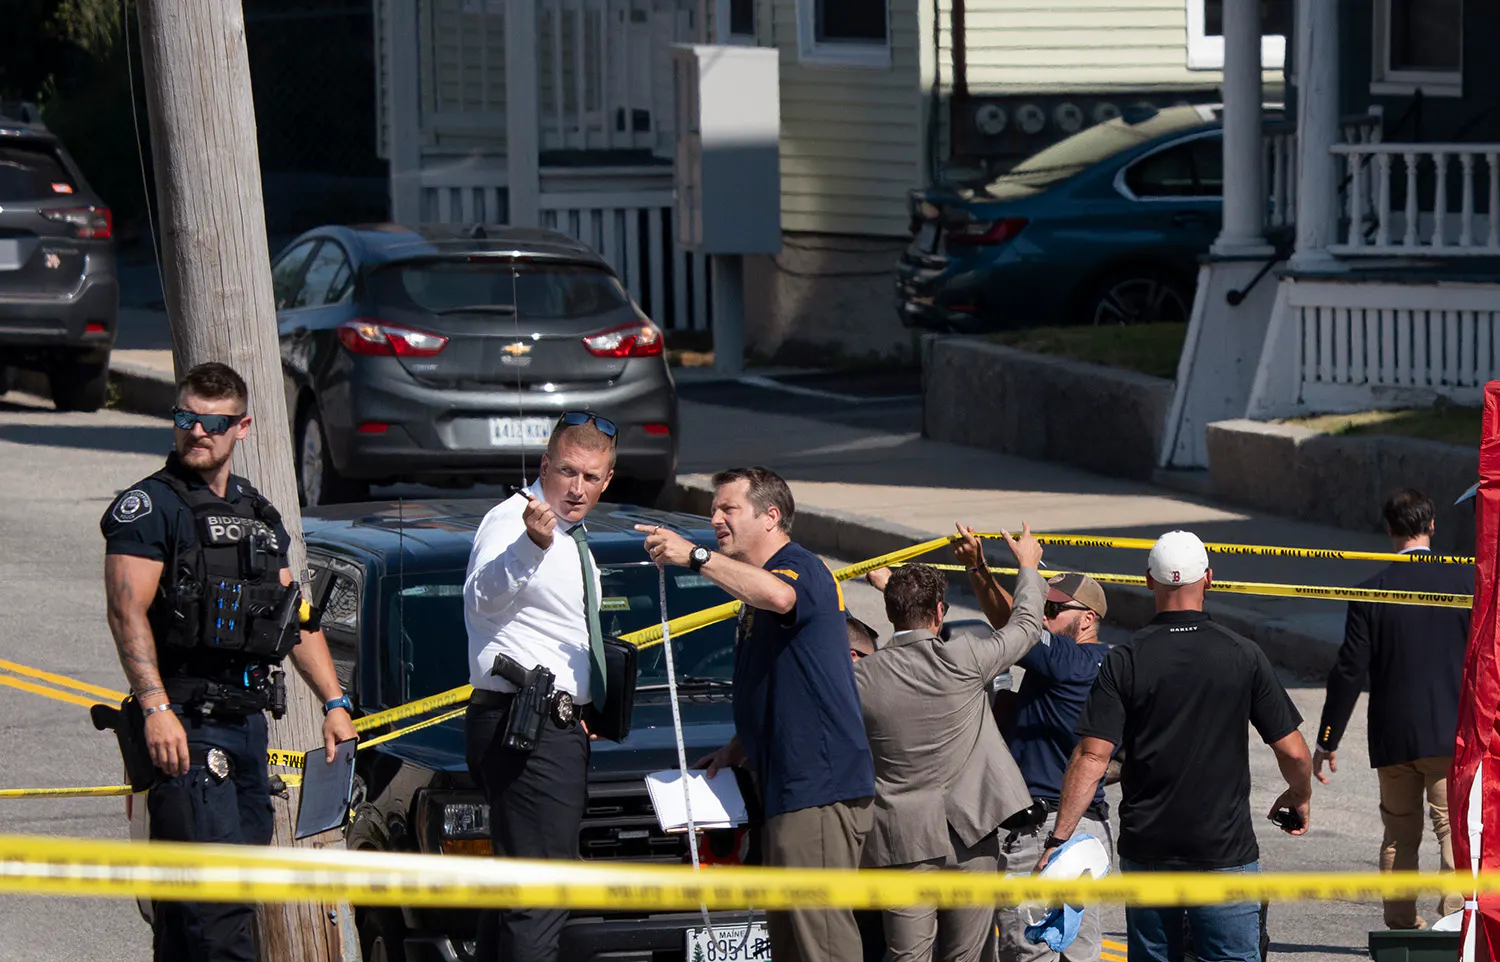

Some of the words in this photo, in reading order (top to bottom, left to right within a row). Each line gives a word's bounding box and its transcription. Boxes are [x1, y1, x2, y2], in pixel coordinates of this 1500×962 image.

[207, 516, 271, 531] BIDDEFO
[1172, 570, 1181, 583] B
[719, 929, 746, 939] MAINE
[707, 939, 739, 962] 895
